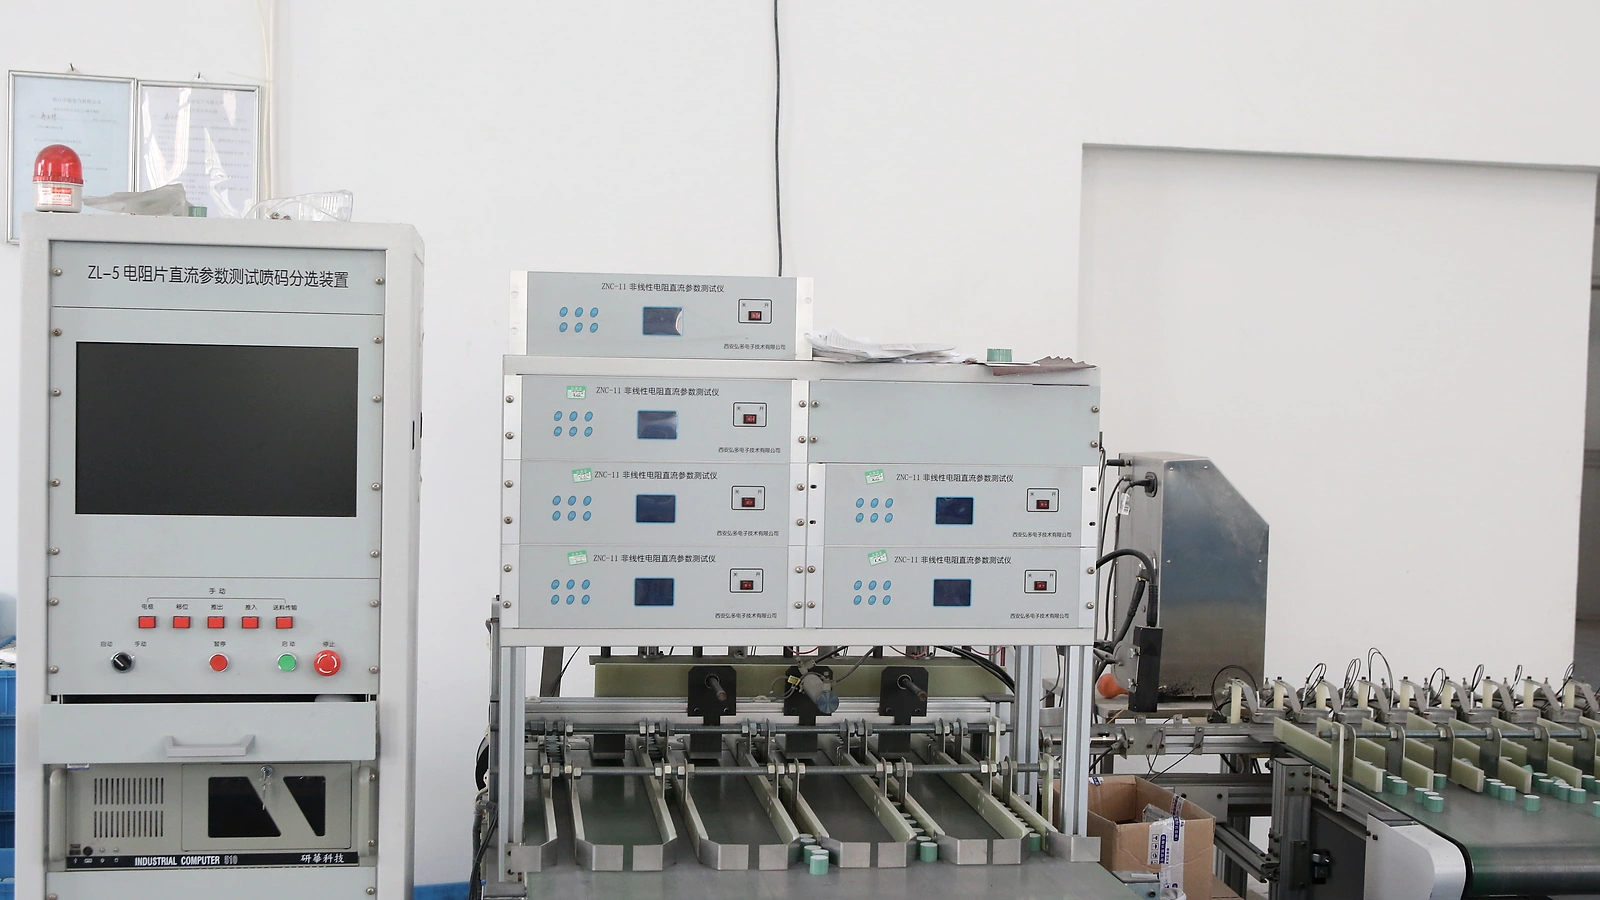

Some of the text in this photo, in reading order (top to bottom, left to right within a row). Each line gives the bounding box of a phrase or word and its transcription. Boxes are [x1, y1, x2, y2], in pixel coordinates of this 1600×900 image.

[87, 264, 349, 289] ZL-5 电阻片直流参数测试喷码分选装置
[601, 282, 725, 293] ZNC-11 非线性电阻直流参数测试仪
[595, 386, 622, 395] ZNC-11
[623, 386, 720, 397] 非线性电阻直流参数测试仪
[594, 470, 620, 479] ZNC-11
[622, 470, 718, 480] 非线性电阻直流参数测试仪
[896, 473, 1014, 483] ZNC-11 非线性电阻直流参数测试仪
[592, 554, 619, 562] ZNC-11
[620, 554, 716, 563] 非线性电阻直流参数测试仪
[894, 555, 919, 564] ZNC-11
[920, 555, 1012, 565] 非线性电阻直流参数测试仪
[208, 587, 226, 596] 手动
[210, 603, 224, 611] 推出
[244, 603, 258, 612] 推入
[134, 640, 147, 648] 手动
[213, 640, 227, 648] 暂停
[135, 857, 177, 866] INDUSTRIAL
[181, 856, 220, 865] COMPUTER
[300, 853, 345, 863] 研華科技
